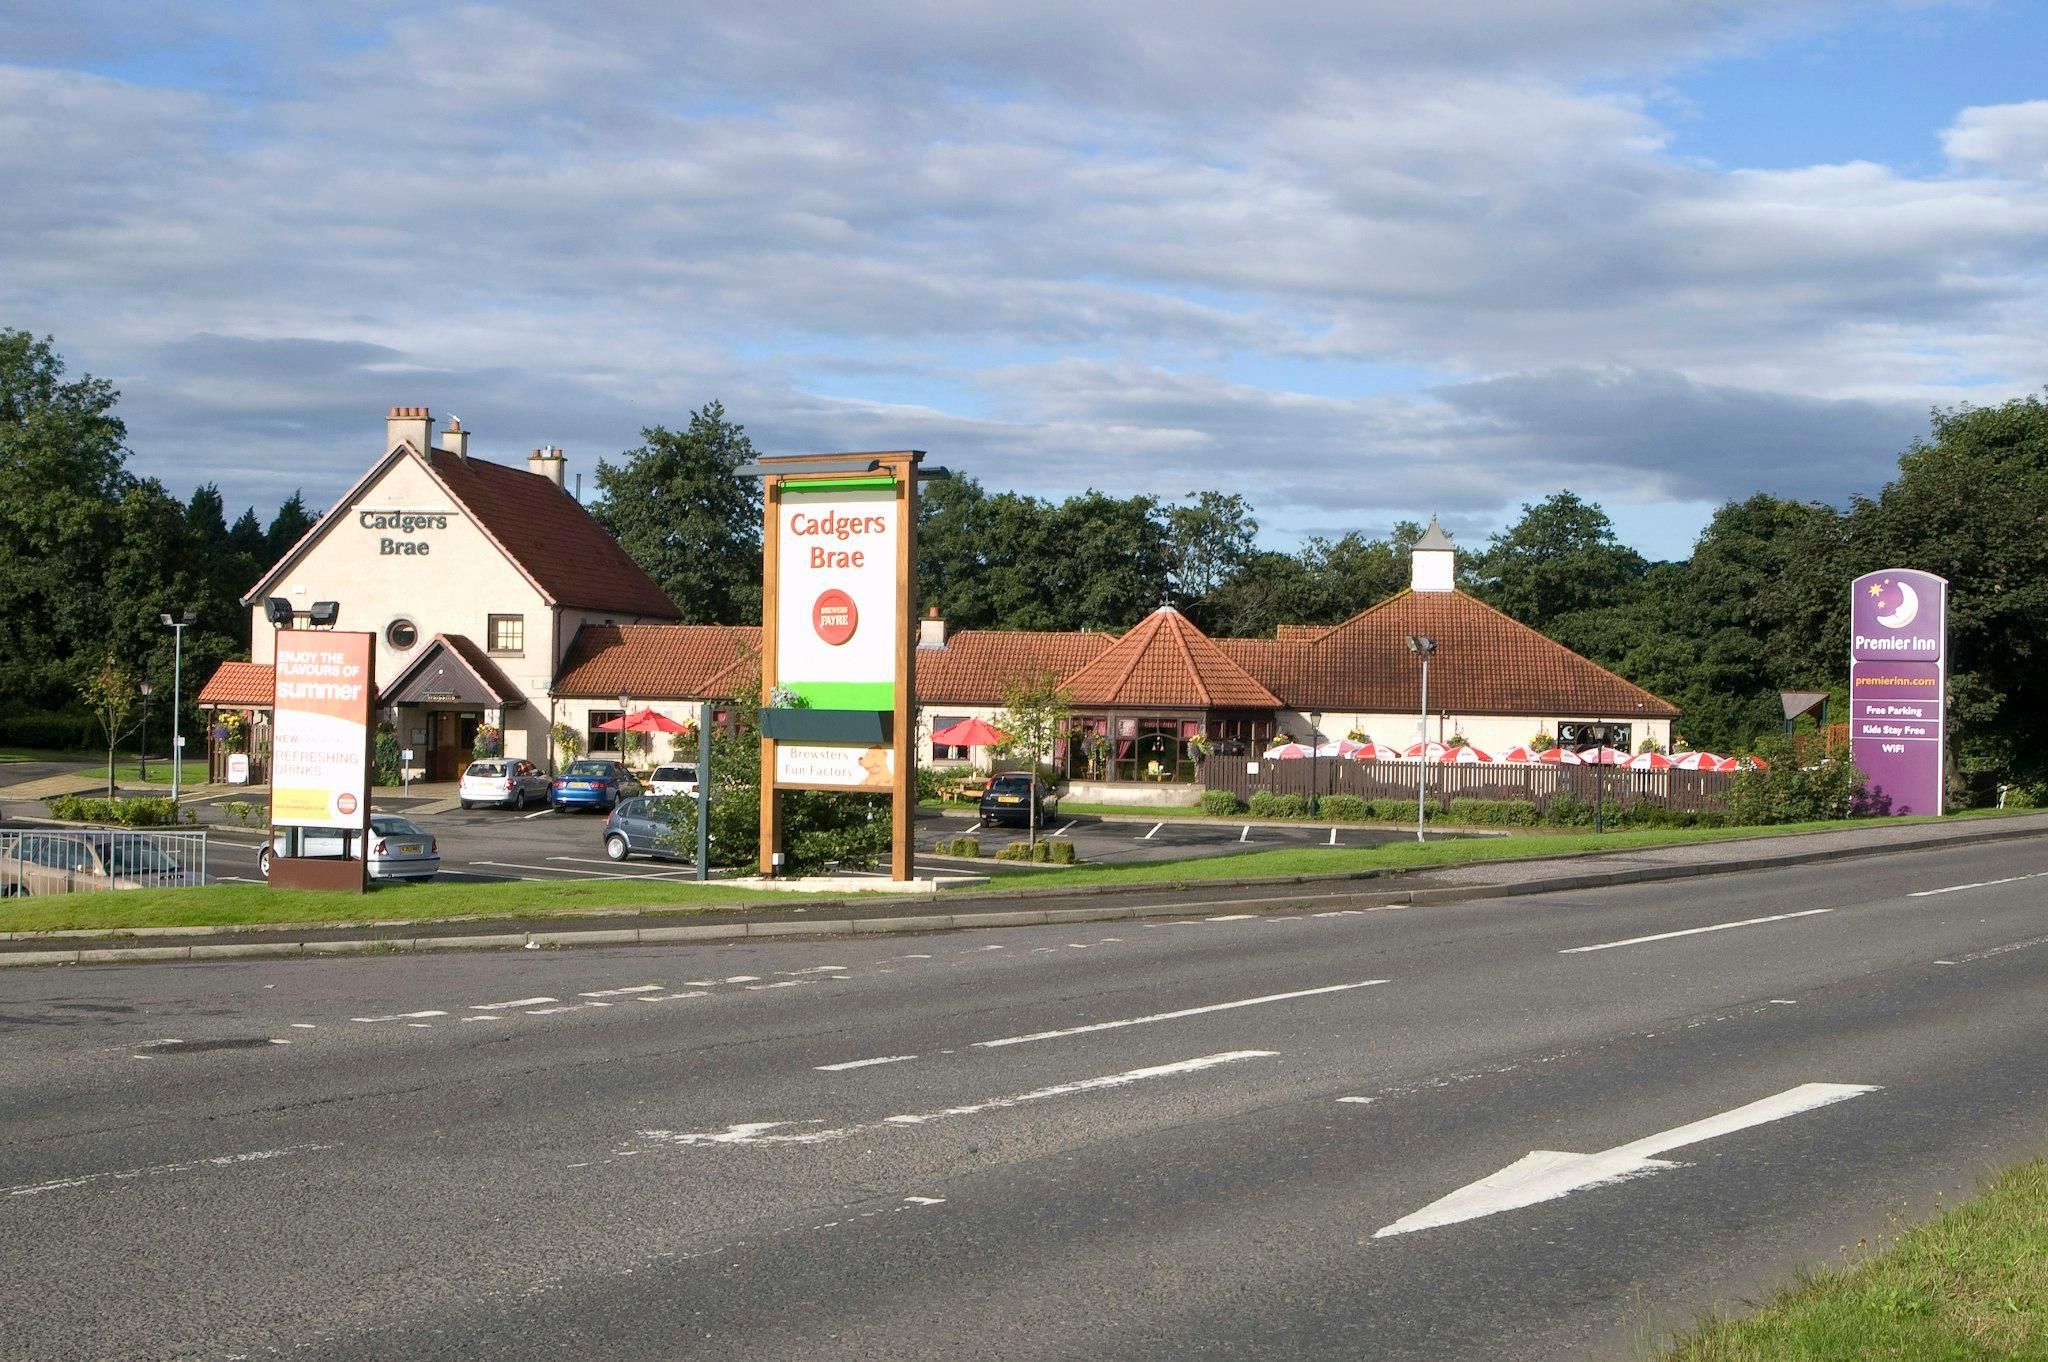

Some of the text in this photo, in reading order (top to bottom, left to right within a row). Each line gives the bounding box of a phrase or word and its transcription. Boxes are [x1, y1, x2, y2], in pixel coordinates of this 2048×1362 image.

[360, 510, 447, 533] Cadgers
[790, 510, 885, 540] Cadgers
[380, 538, 429, 555] Brae
[810, 546, 864, 568] Brae
[820, 615, 848, 626] FAYRE
[1855, 635, 1936, 650] Premier Inn
[278, 651, 344, 664] ENJOY THE
[277, 663, 360, 677] FLAVOURS OF
[1855, 676, 1936, 687] premierinn.com
[277, 681, 362, 700] summer
[1866, 706, 1922, 717] Free Parking
[1862, 725, 1925, 736] Kids Stay Free
[274, 735, 299, 743] NEW
[790, 748, 849, 760] Brewsters
[1882, 744, 1905, 753] WiFi
[275, 751, 360, 765] REFRESHING
[275, 764, 323, 776] DRINKS
[785, 764, 853, 777] Fun Factory
